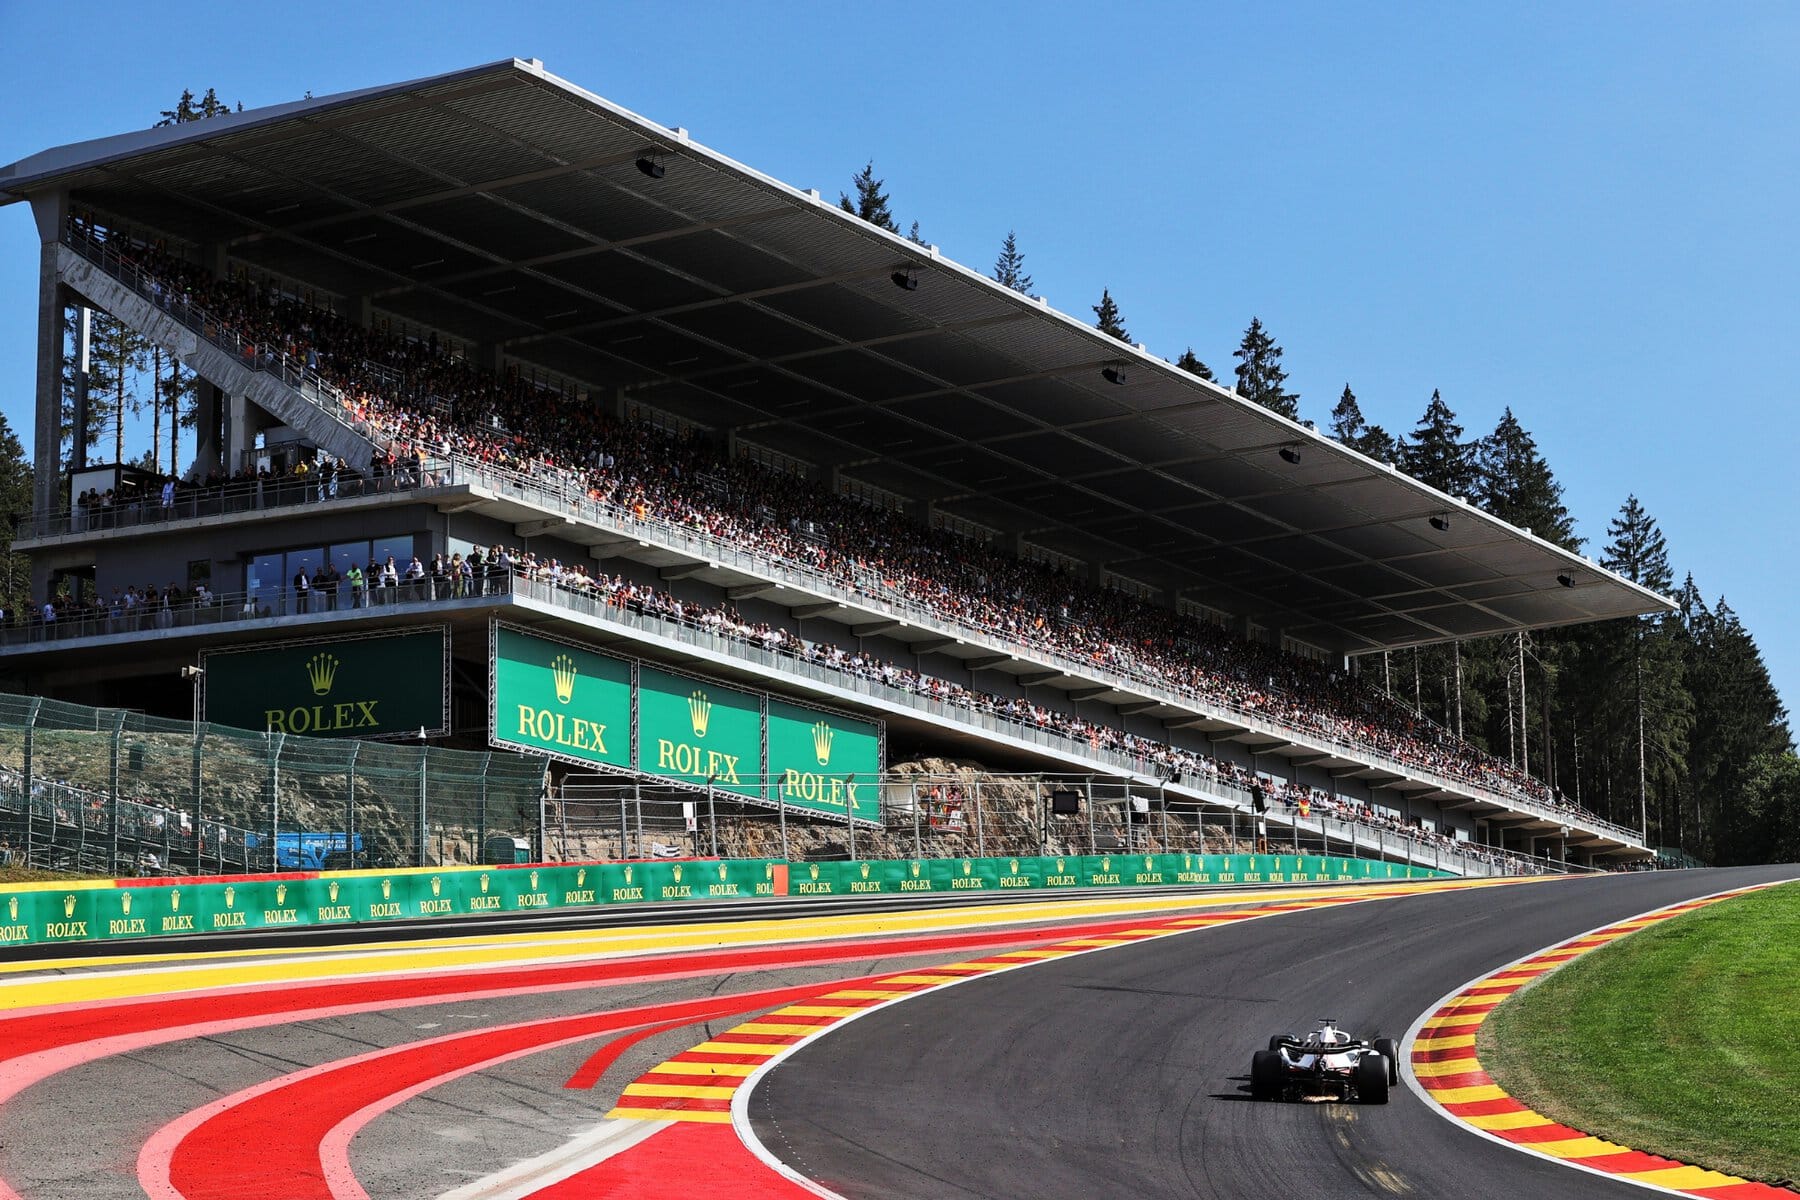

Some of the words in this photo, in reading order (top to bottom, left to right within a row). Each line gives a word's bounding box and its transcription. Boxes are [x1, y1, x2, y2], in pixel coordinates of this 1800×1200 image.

[265, 701, 379, 733] ROLEX
[518, 704, 607, 754] ROLEX
[658, 739, 740, 784] ROLEX
[785, 768, 860, 809] ROLEX
[952, 878, 982, 888] ROLEX
[1001, 877, 1029, 887] ROLEX
[1048, 876, 1075, 885] ROLEX
[1093, 874, 1119, 884] ROLEX
[1137, 873, 1162, 883] ROLEX
[663, 886, 691, 897] ROLEX
[710, 884, 739, 895] ROLEX
[756, 883, 773, 894] ROL
[800, 883, 831, 893] ROLEX
[852, 882, 880, 892] ROLEX
[901, 880, 931, 890] ROLEX
[518, 894, 548, 907] ROLEX
[566, 891, 594, 903] ROLEX
[614, 888, 642, 900] ROLEX
[371, 903, 401, 916] ROLEX
[420, 900, 451, 913] ROLEX
[471, 897, 500, 910] ROLEX
[214, 912, 246, 927] ROLEX
[265, 910, 298, 923] ROLEX
[319, 906, 351, 920] ROLEX
[47, 922, 87, 937] ROLEX
[110, 919, 145, 934] ROLEX
[163, 916, 193, 930] ROLEX
